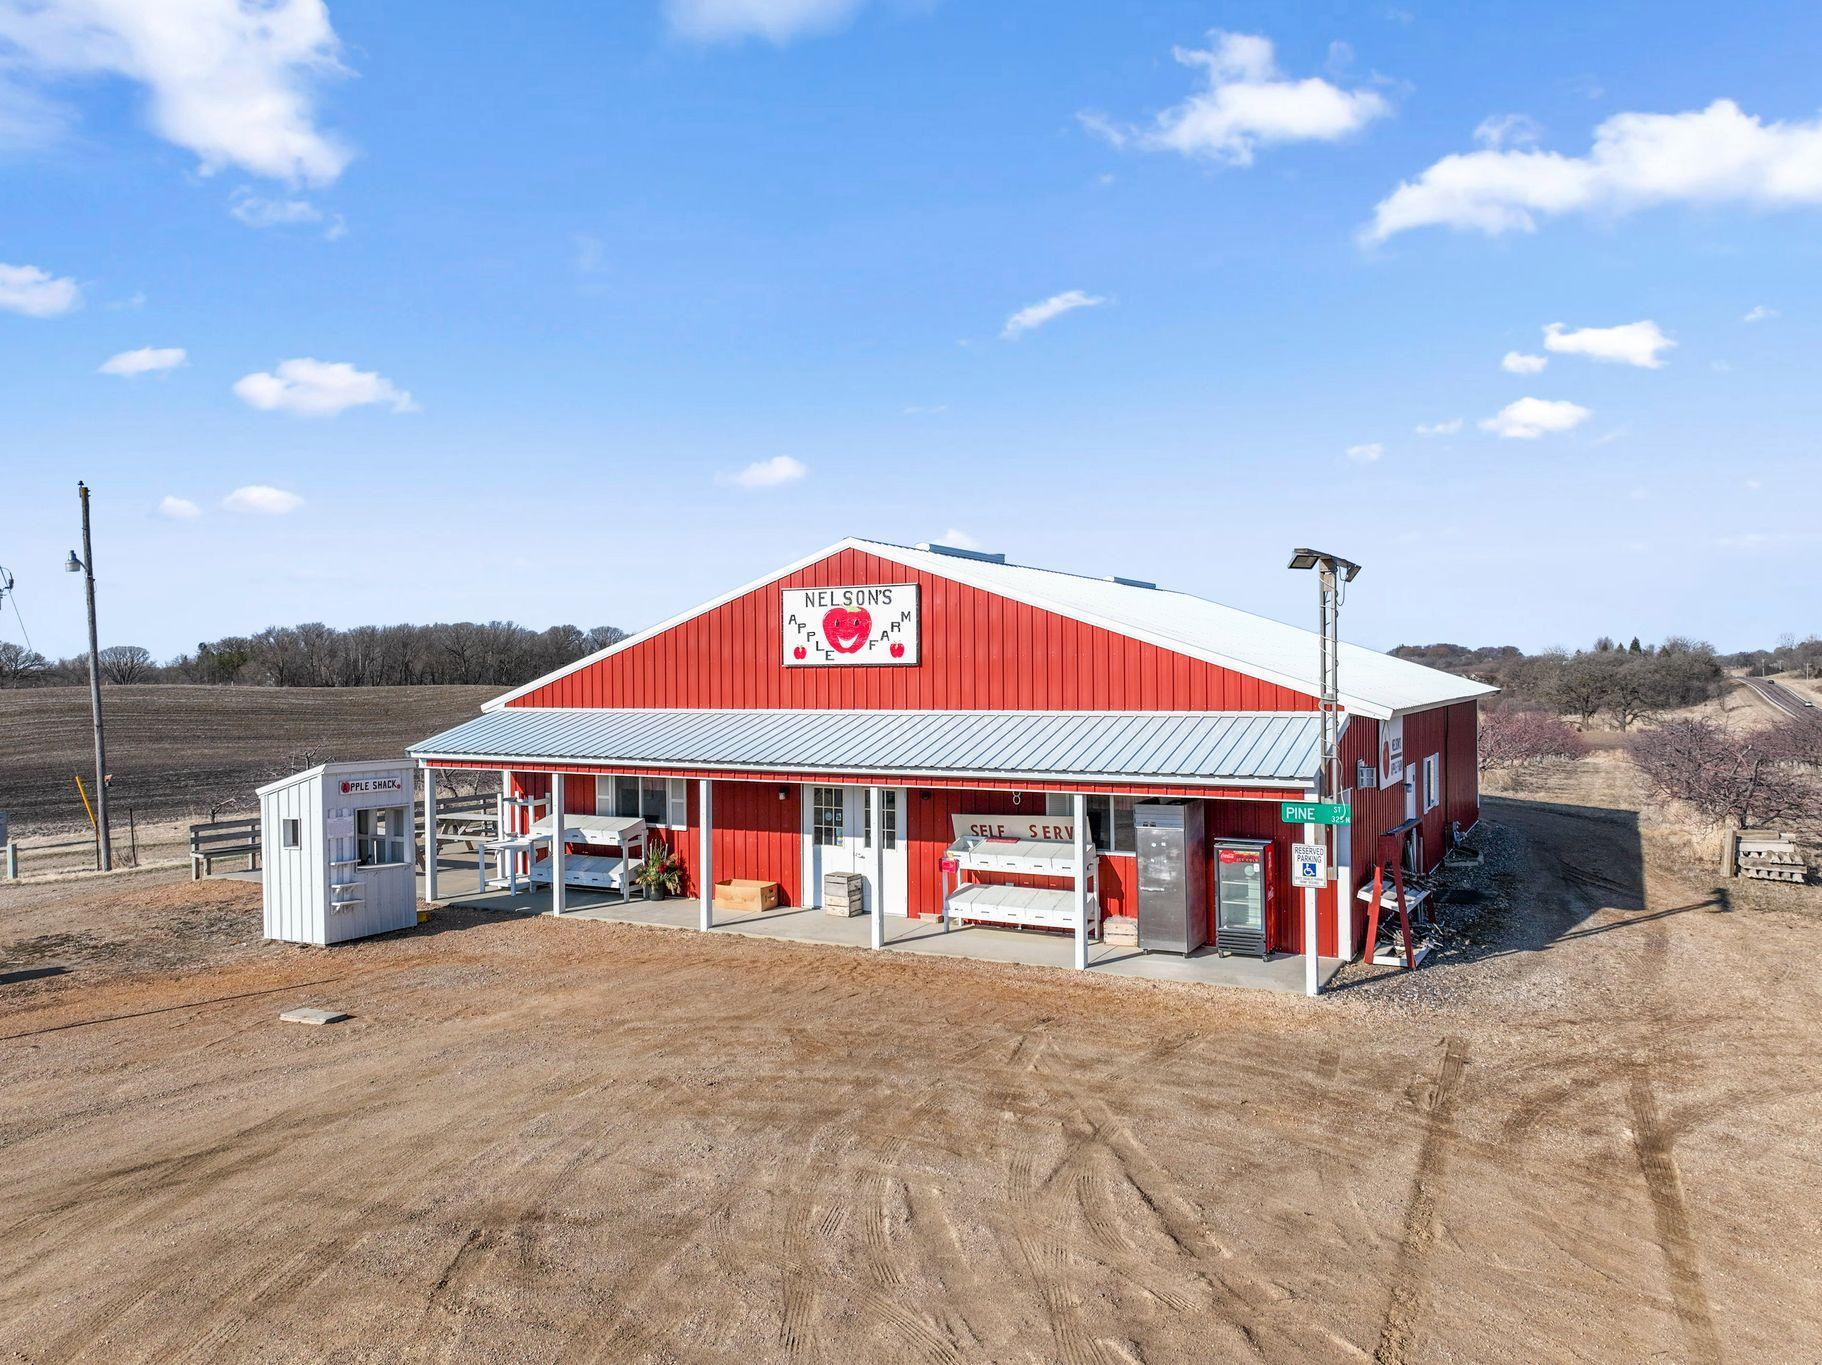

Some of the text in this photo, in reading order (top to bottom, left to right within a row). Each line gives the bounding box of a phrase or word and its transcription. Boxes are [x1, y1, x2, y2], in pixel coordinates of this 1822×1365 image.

[805, 589, 893, 607] NELSON'S
[788, 611, 912, 661] APPLE FARM
[372, 780, 397, 790] SHACK
[1286, 807, 1316, 820] PINE
[970, 824, 1005, 837] SELF
[1294, 847, 1323, 855] RESERVED
[1297, 855, 1322, 863] PARKING
